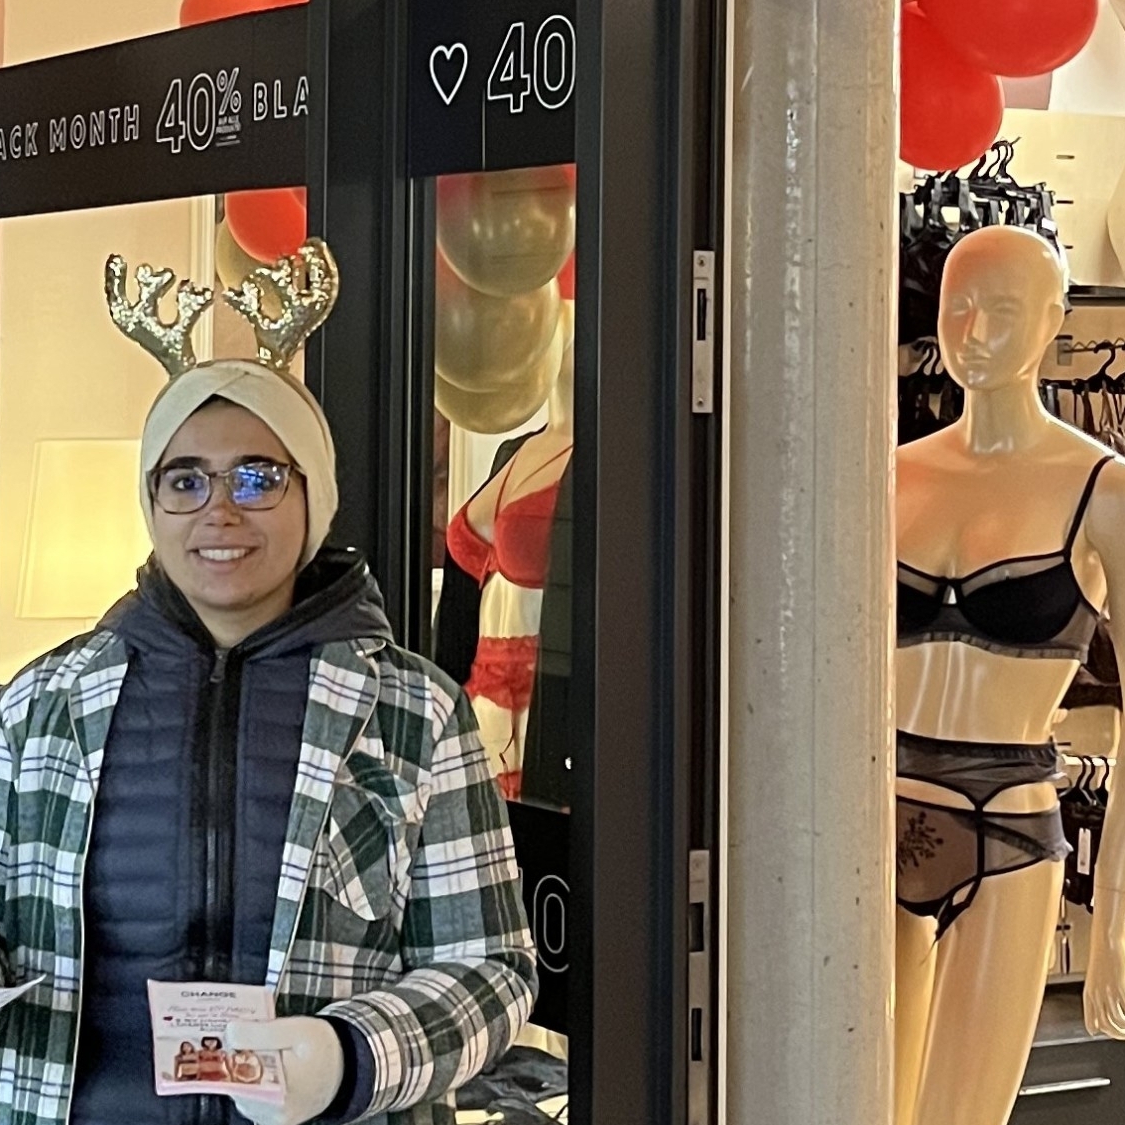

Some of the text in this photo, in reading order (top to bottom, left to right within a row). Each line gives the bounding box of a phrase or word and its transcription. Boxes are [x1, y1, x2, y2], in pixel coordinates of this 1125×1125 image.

[487, 14, 576, 113] 40
[49, 104, 140, 153] MONTH
[155, 67, 242, 154] 40%
[253, 76, 309, 121] BLA
